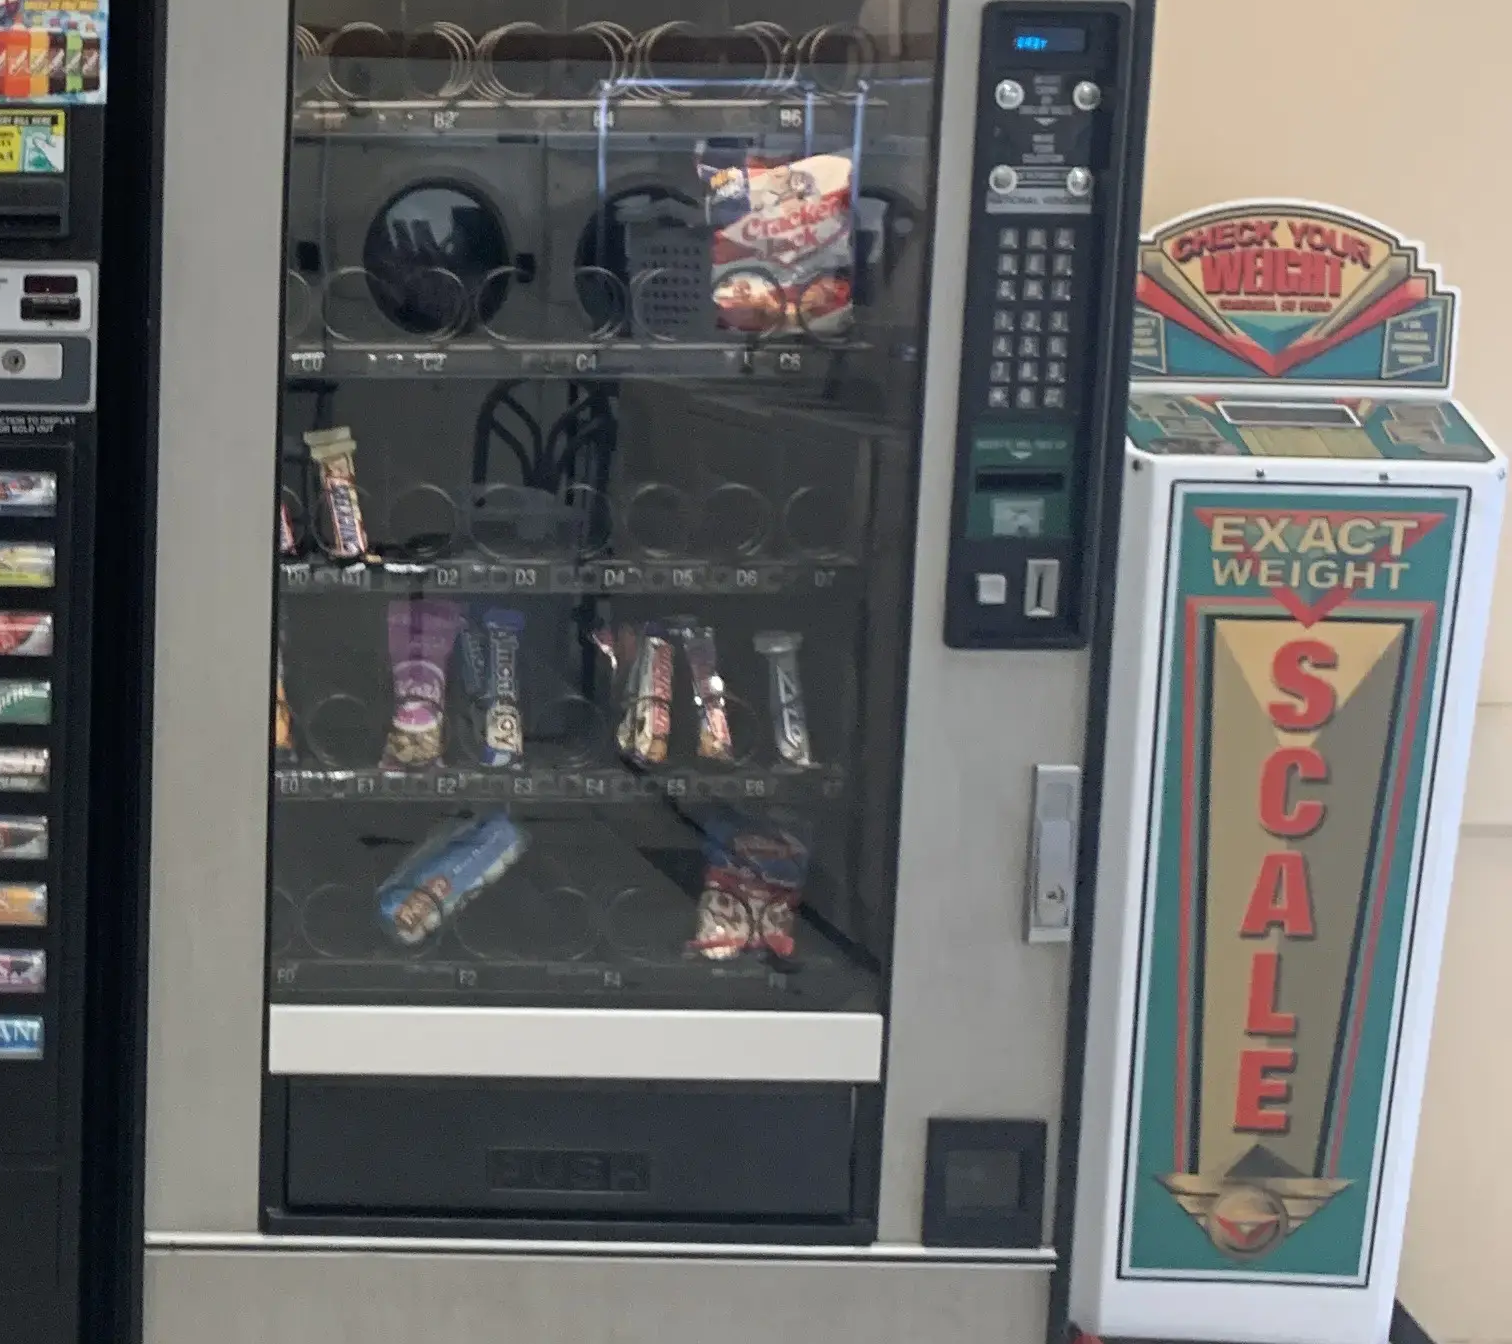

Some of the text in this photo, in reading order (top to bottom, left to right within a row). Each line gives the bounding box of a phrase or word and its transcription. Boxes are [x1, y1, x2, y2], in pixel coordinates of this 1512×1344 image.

[434, 111, 458, 129] B2
[741, 193, 846, 243] Cracker
[1172, 220, 1371, 269] CHECK YOUR
[1201, 248, 1343, 297] WEIGHT
[576, 354, 597, 372] C4
[1211, 514, 1419, 557] EXACT
[438, 568, 458, 586] D2
[515, 568, 536, 586] D3
[604, 569, 625, 587] D4
[737, 569, 758, 587] D6
[1212, 559, 1410, 590] WEIGHT
[438, 777, 457, 794] E2
[1233, 638, 1339, 1134] SCALE
[458, 968, 477, 986] F2
[604, 970, 622, 987] F4
